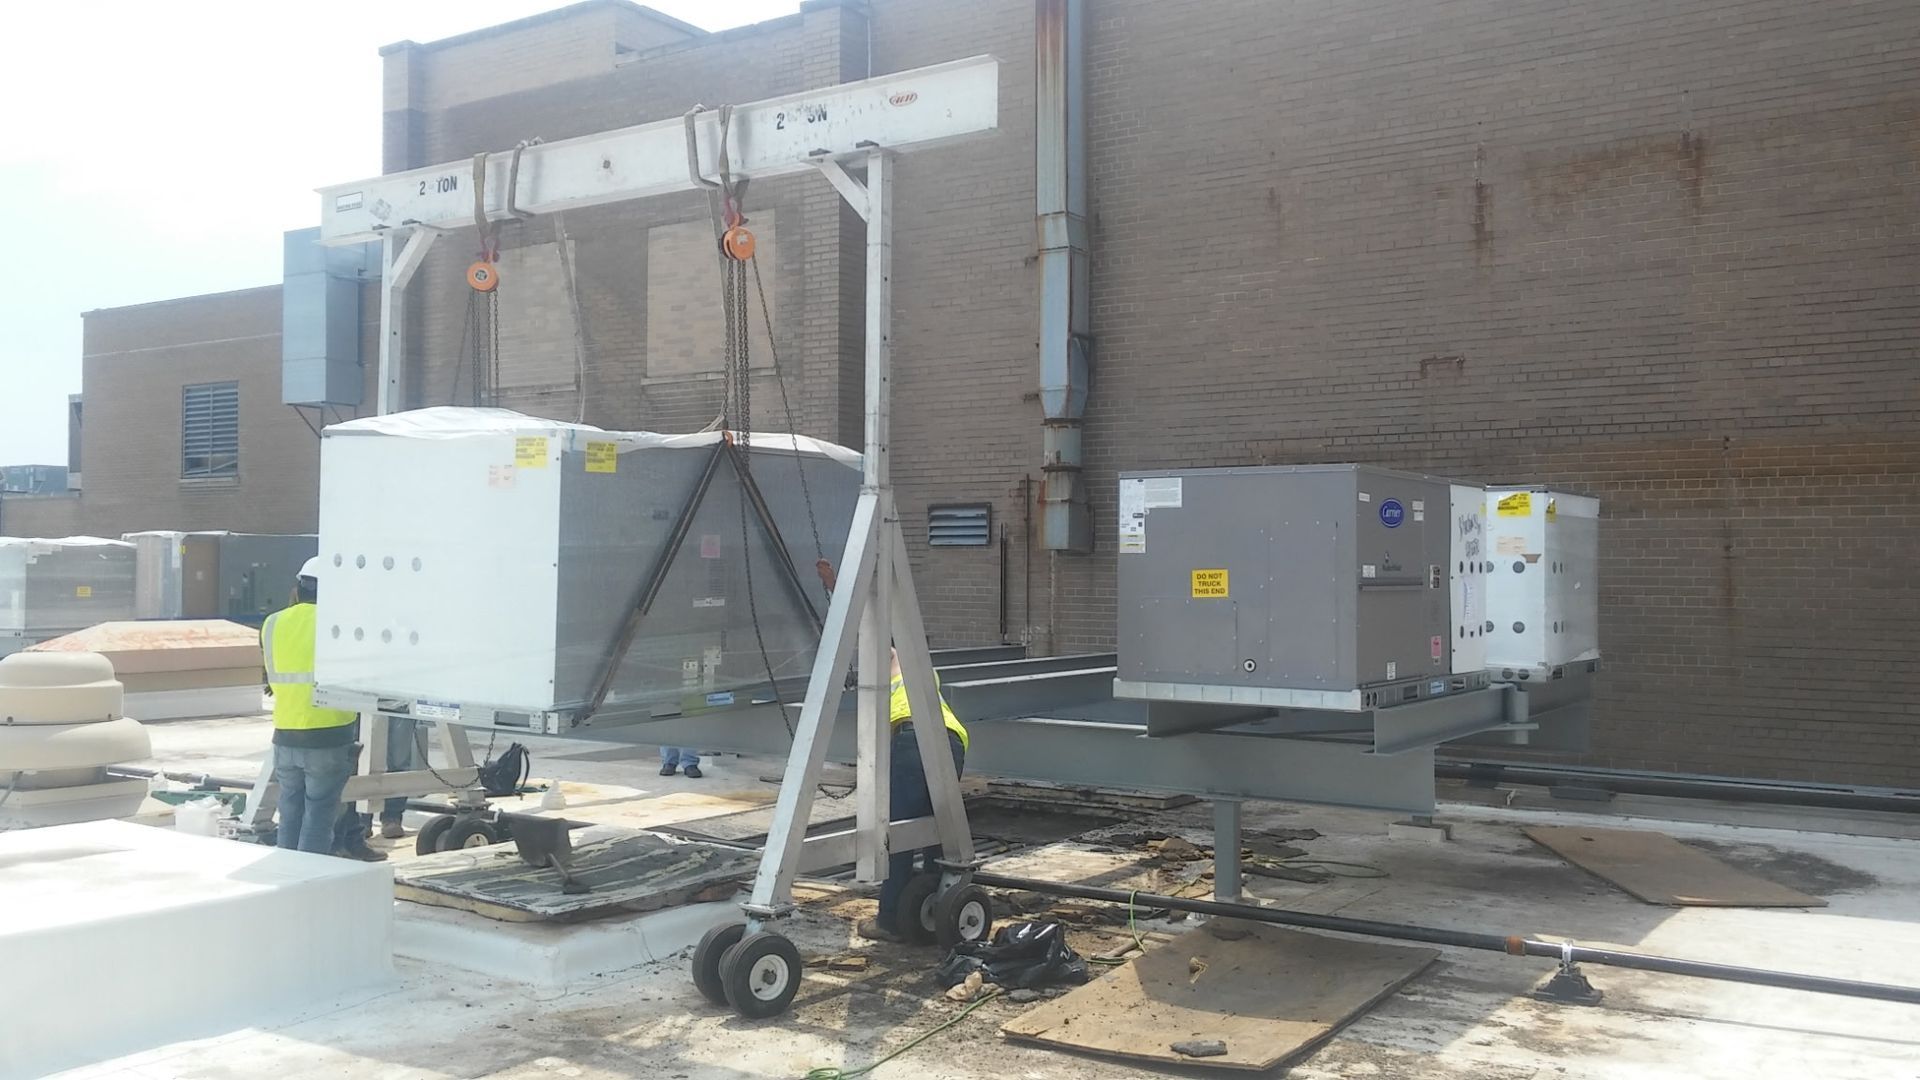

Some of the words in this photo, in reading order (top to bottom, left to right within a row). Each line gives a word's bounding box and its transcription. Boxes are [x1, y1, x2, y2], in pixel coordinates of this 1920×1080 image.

[776, 112, 785, 130] 2
[419, 180, 426, 196] 2
[435, 175, 458, 194] TON
[1208, 572, 1223, 580] NOT
